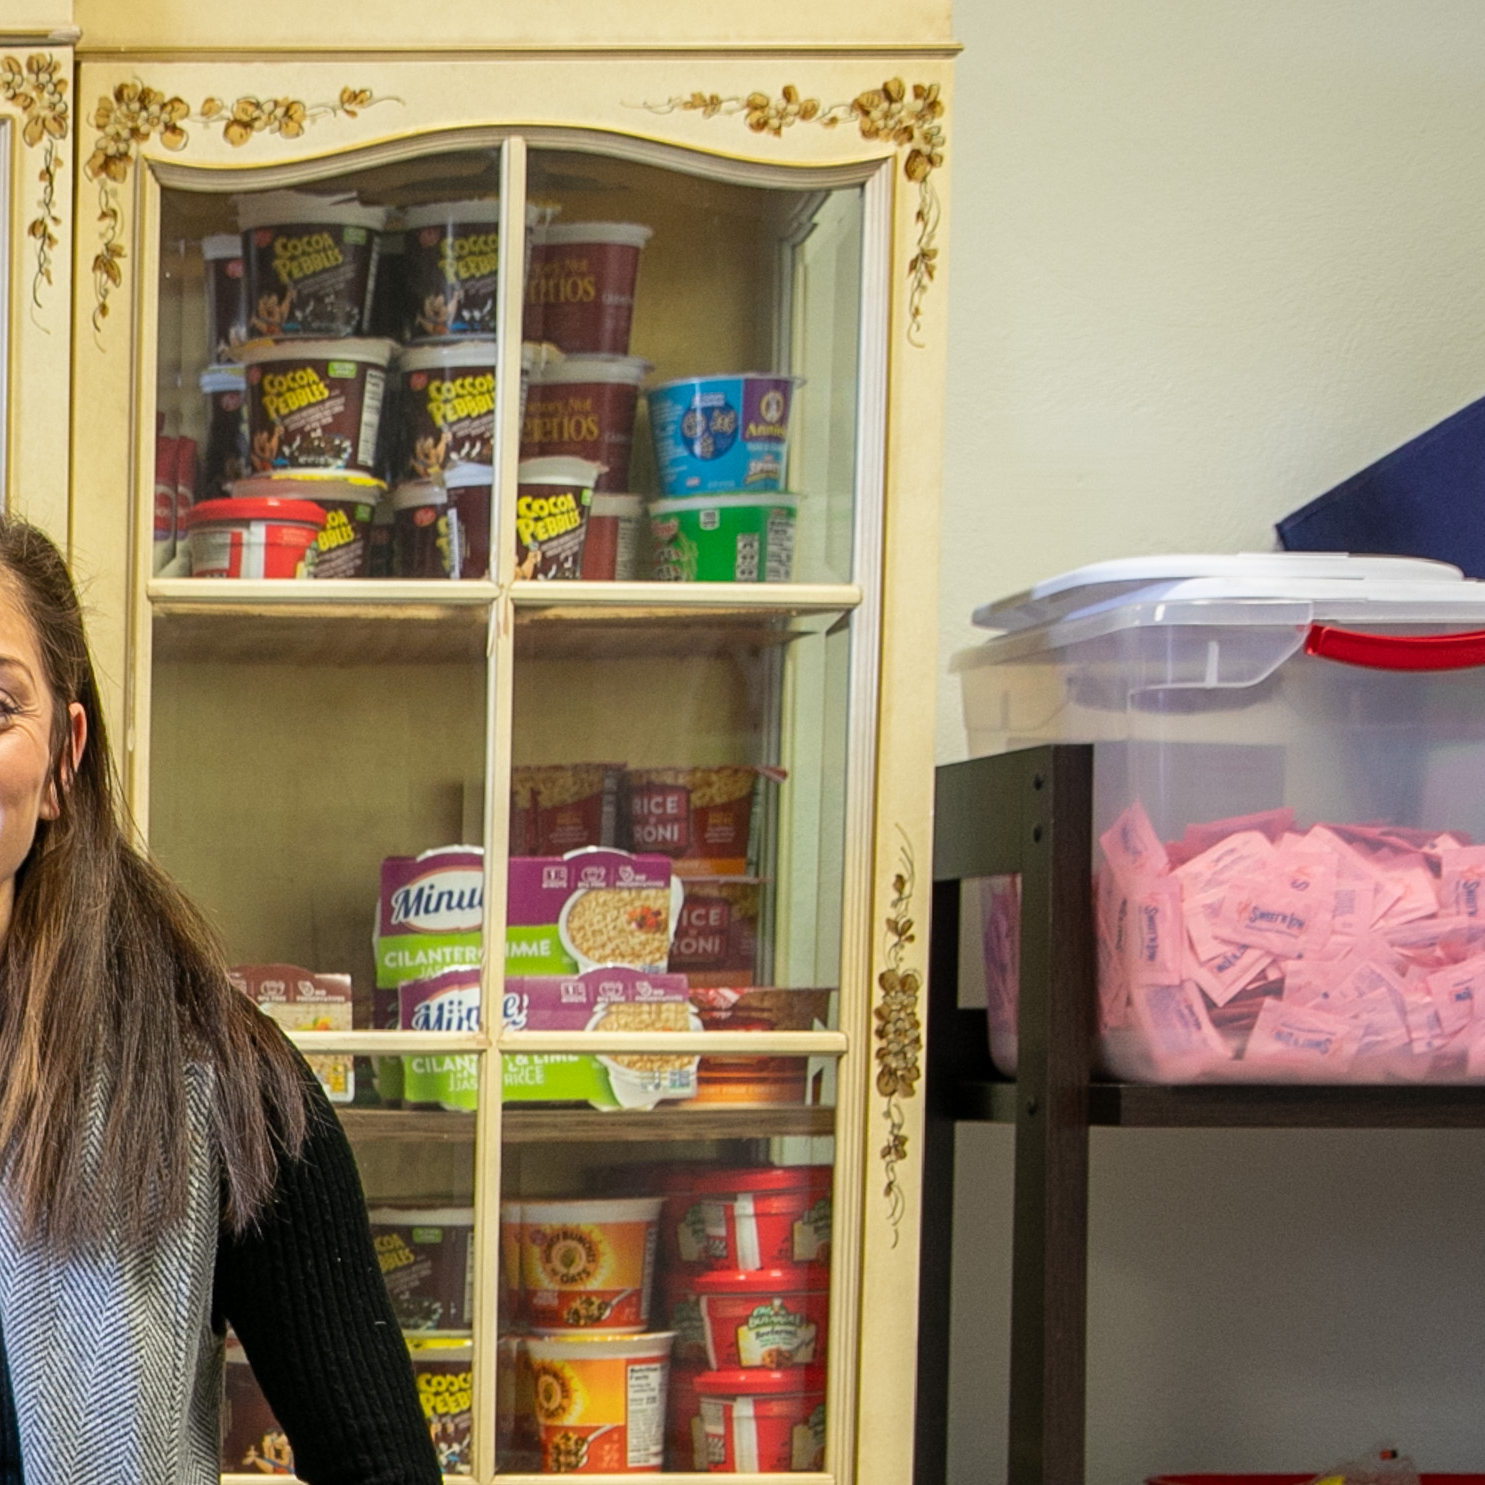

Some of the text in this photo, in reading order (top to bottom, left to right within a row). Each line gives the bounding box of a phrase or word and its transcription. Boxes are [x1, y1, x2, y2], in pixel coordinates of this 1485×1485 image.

[263, 366, 320, 393] COCOA
[262, 382, 329, 420] PEBBLES
[518, 493, 577, 518] COCOA
[517, 510, 581, 547] PEBBLES
